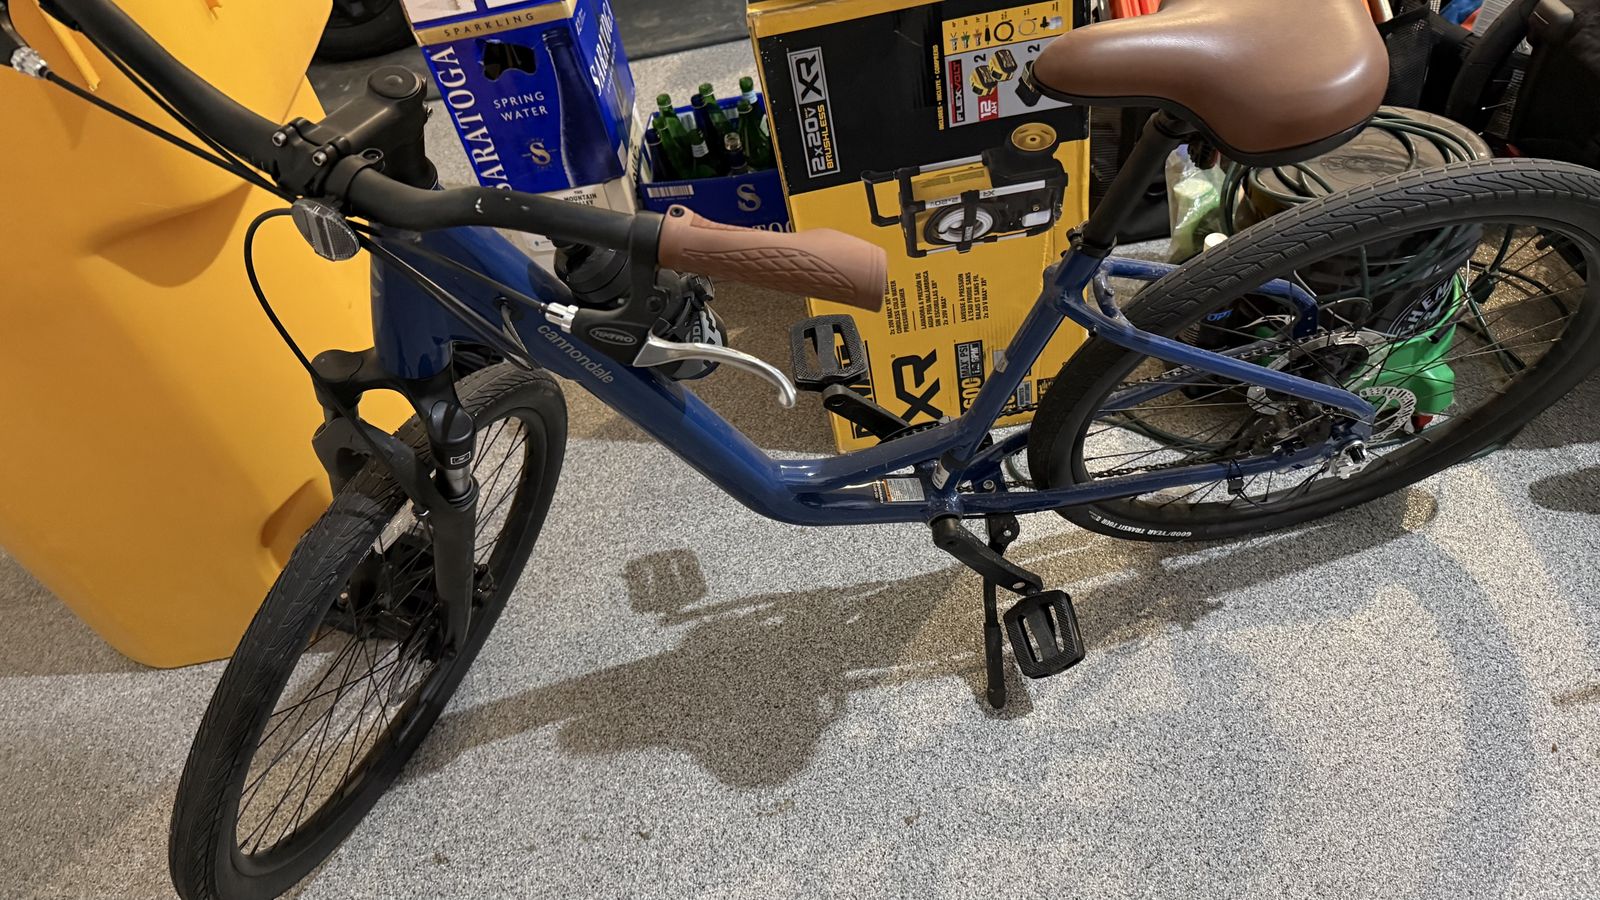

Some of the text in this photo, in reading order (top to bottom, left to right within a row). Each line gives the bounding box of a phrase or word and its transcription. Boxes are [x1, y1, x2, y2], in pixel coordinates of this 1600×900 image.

[443, 13, 535, 37] SPARKLING
[1028, 44, 1040, 54] 2
[974, 54, 986, 63] 2
[493, 91, 545, 109] SPRING
[953, 62, 964, 121] FLEXVOLT
[500, 106, 548, 122] WATER
[979, 100, 992, 118] 12
[817, 104, 834, 169] BRUSHLESS
[529, 141, 551, 165] S
[736, 184, 761, 212] S
[890, 280, 898, 297] WATER
[901, 309, 909, 332] PRESSURE
[592, 330, 635, 344] TEKTRO
[537, 324, 615, 385] cannondale
[959, 345, 968, 357] PSI
[892, 349, 943, 424] XR
[1118, 524, 1146, 534] TRANSIT
